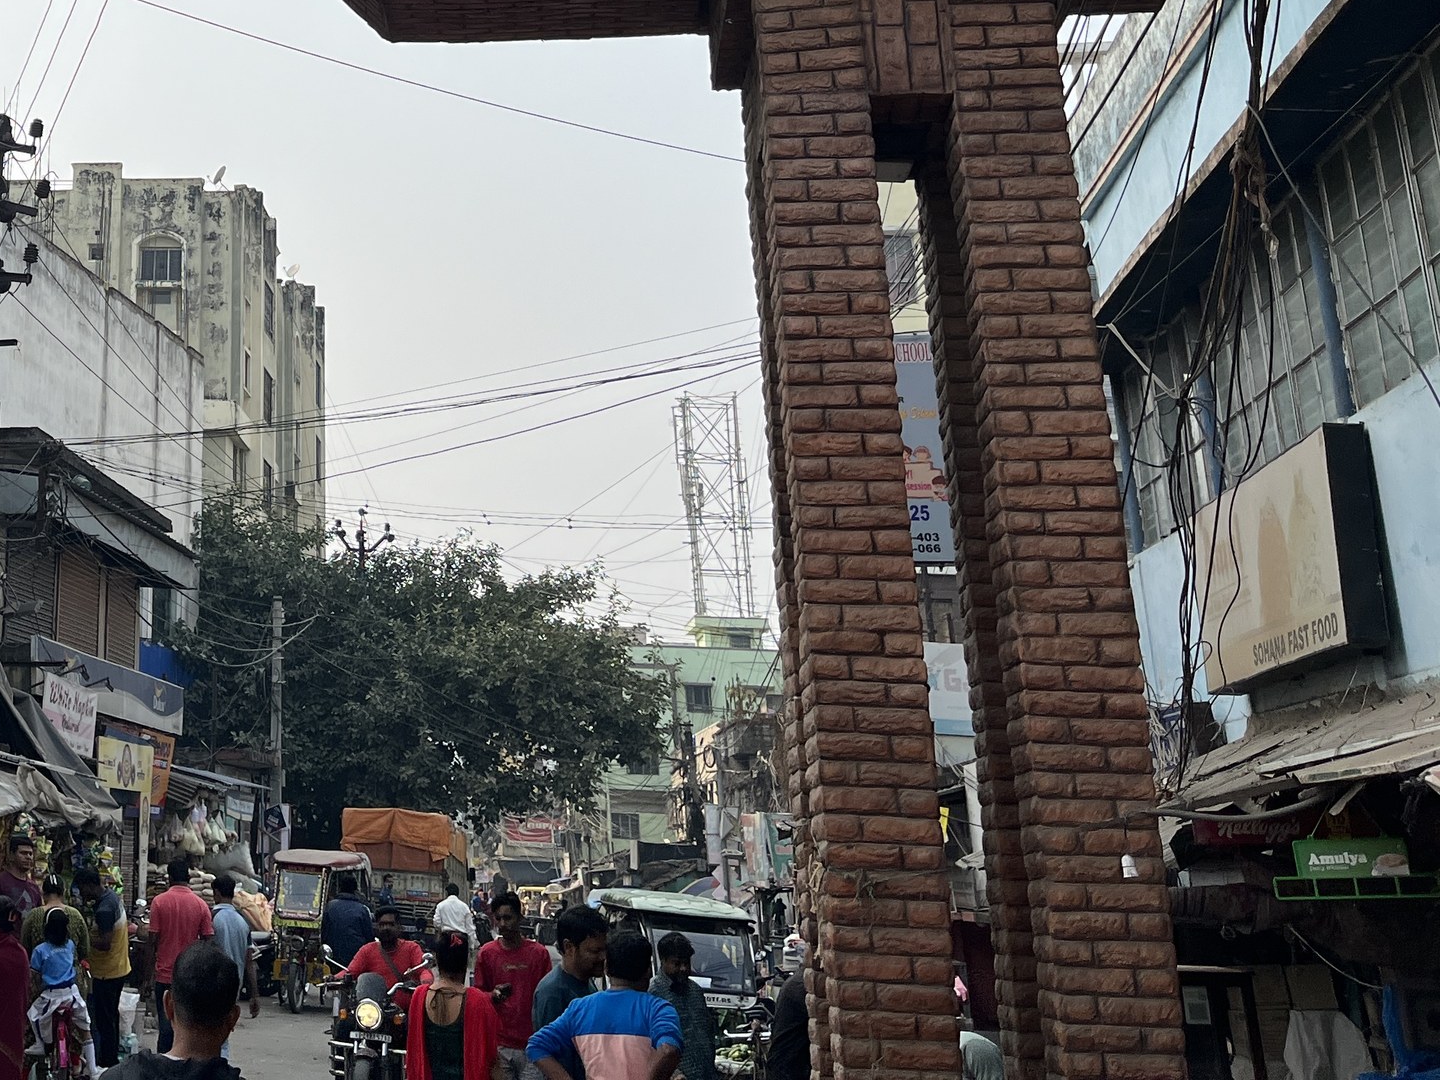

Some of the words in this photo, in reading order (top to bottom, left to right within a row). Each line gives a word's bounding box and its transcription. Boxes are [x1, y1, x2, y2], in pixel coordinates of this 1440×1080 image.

[895, 342, 932, 362] CHOOL
[1252, 638, 1287, 667] SOHANA
[1287, 624, 1310, 653] FAST
[1312, 612, 1339, 646] FOOD
[1308, 851, 1368, 867] Amulya
